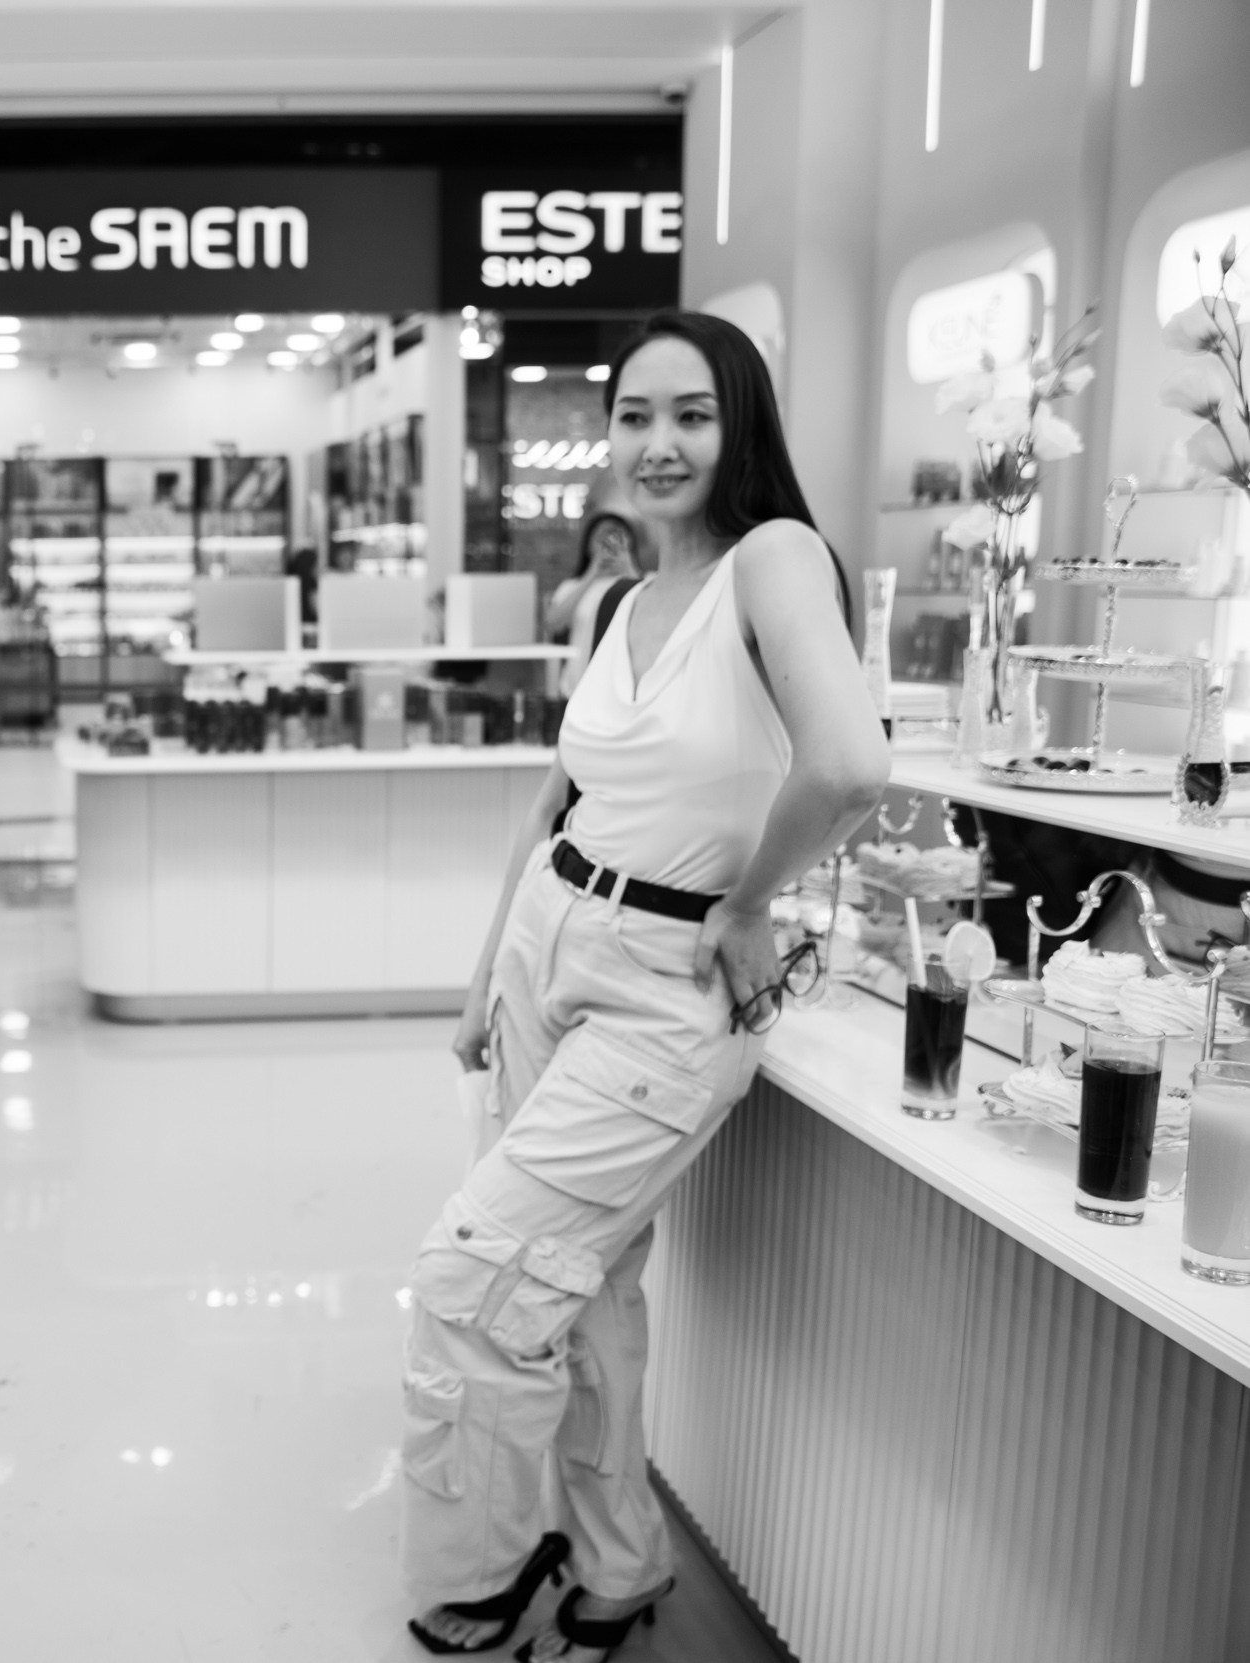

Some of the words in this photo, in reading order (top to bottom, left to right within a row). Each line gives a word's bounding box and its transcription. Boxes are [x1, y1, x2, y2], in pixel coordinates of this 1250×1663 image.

[90, 206, 308, 271] SAEM
[481, 190, 682, 253] ESTE
[481, 255, 592, 288] SHOP
